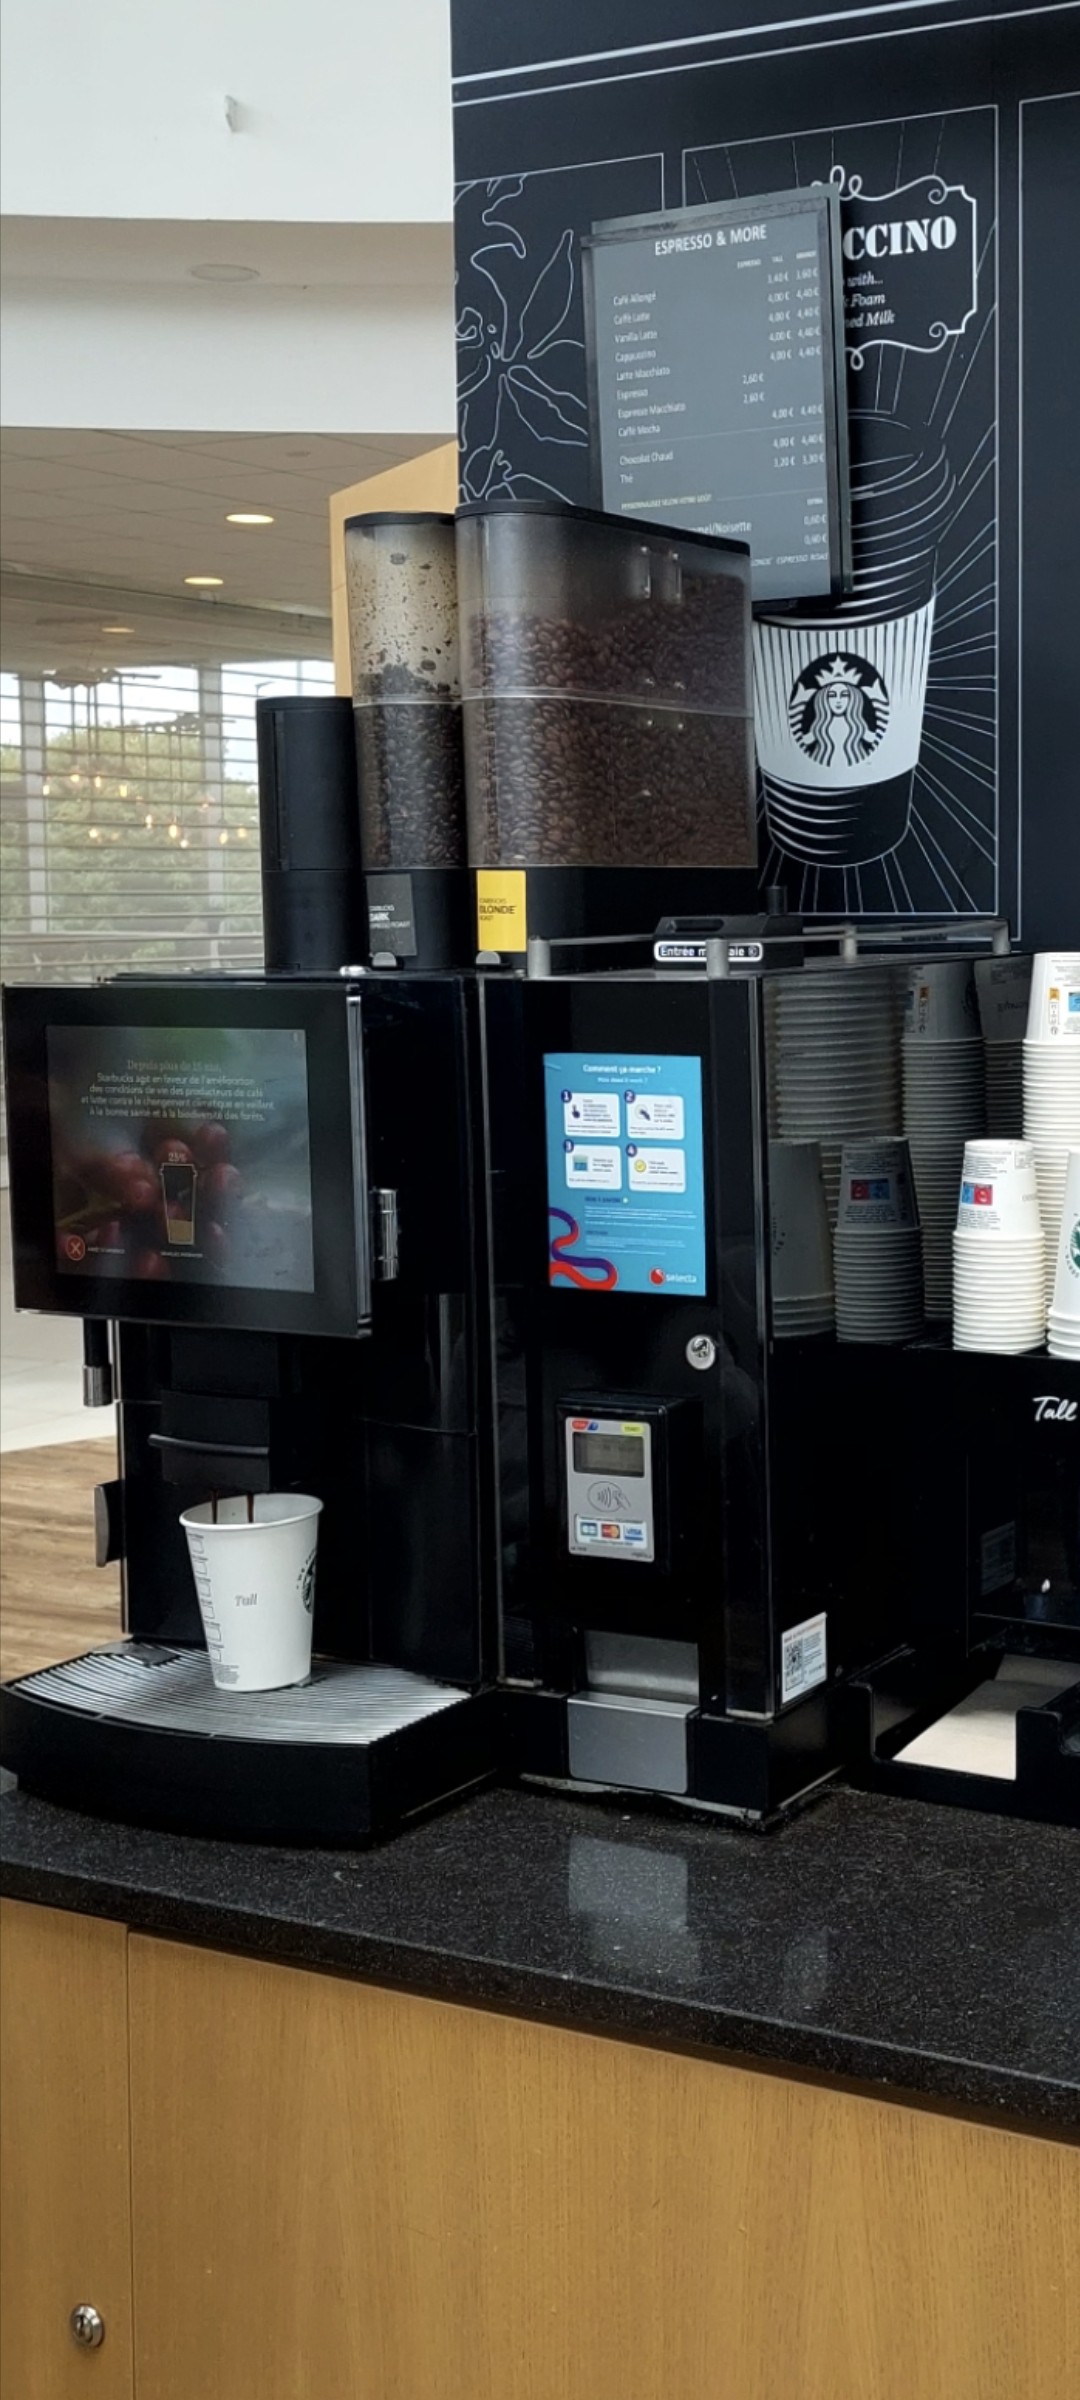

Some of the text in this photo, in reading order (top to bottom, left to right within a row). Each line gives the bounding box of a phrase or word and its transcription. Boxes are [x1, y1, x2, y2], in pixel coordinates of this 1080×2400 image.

[654, 224, 767, 256] ESPRESSO & MORE
[842, 215, 958, 260] CCINO
[613, 294, 628, 306] Café
[630, 291, 656, 304] Allongé
[850, 293, 886, 308] Foam
[632, 312, 651, 323] Latte
[866, 309, 896, 326] Milk
[614, 332, 638, 344] Vanilla
[640, 330, 658, 341] Latte
[614, 350, 657, 364] Cappuccino
[616, 371, 633, 381] Latte
[635, 366, 670, 378] Macchiato
[616, 388, 648, 400] Espresso
[618, 408, 648, 419] Espresso
[649, 402, 686, 415] Macchiato
[636, 424, 660, 435] Mocha
[620, 454, 650, 466] Chocolat
[650, 450, 674, 462] Chaud
[620, 473, 634, 484] Thé
[369, 912, 390, 922] DARK
[660, 946, 695, 956] Entrée
[582, 1064, 618, 1073] Comment
[619, 1066, 628, 1075] ça
[628, 1066, 656, 1074] marche
[185, 1086, 232, 1098] producteurs
[666, 1272, 697, 1284] selecta
[1032, 1396, 1079, 1422] Tall
[234, 1594, 258, 1607] Tall
